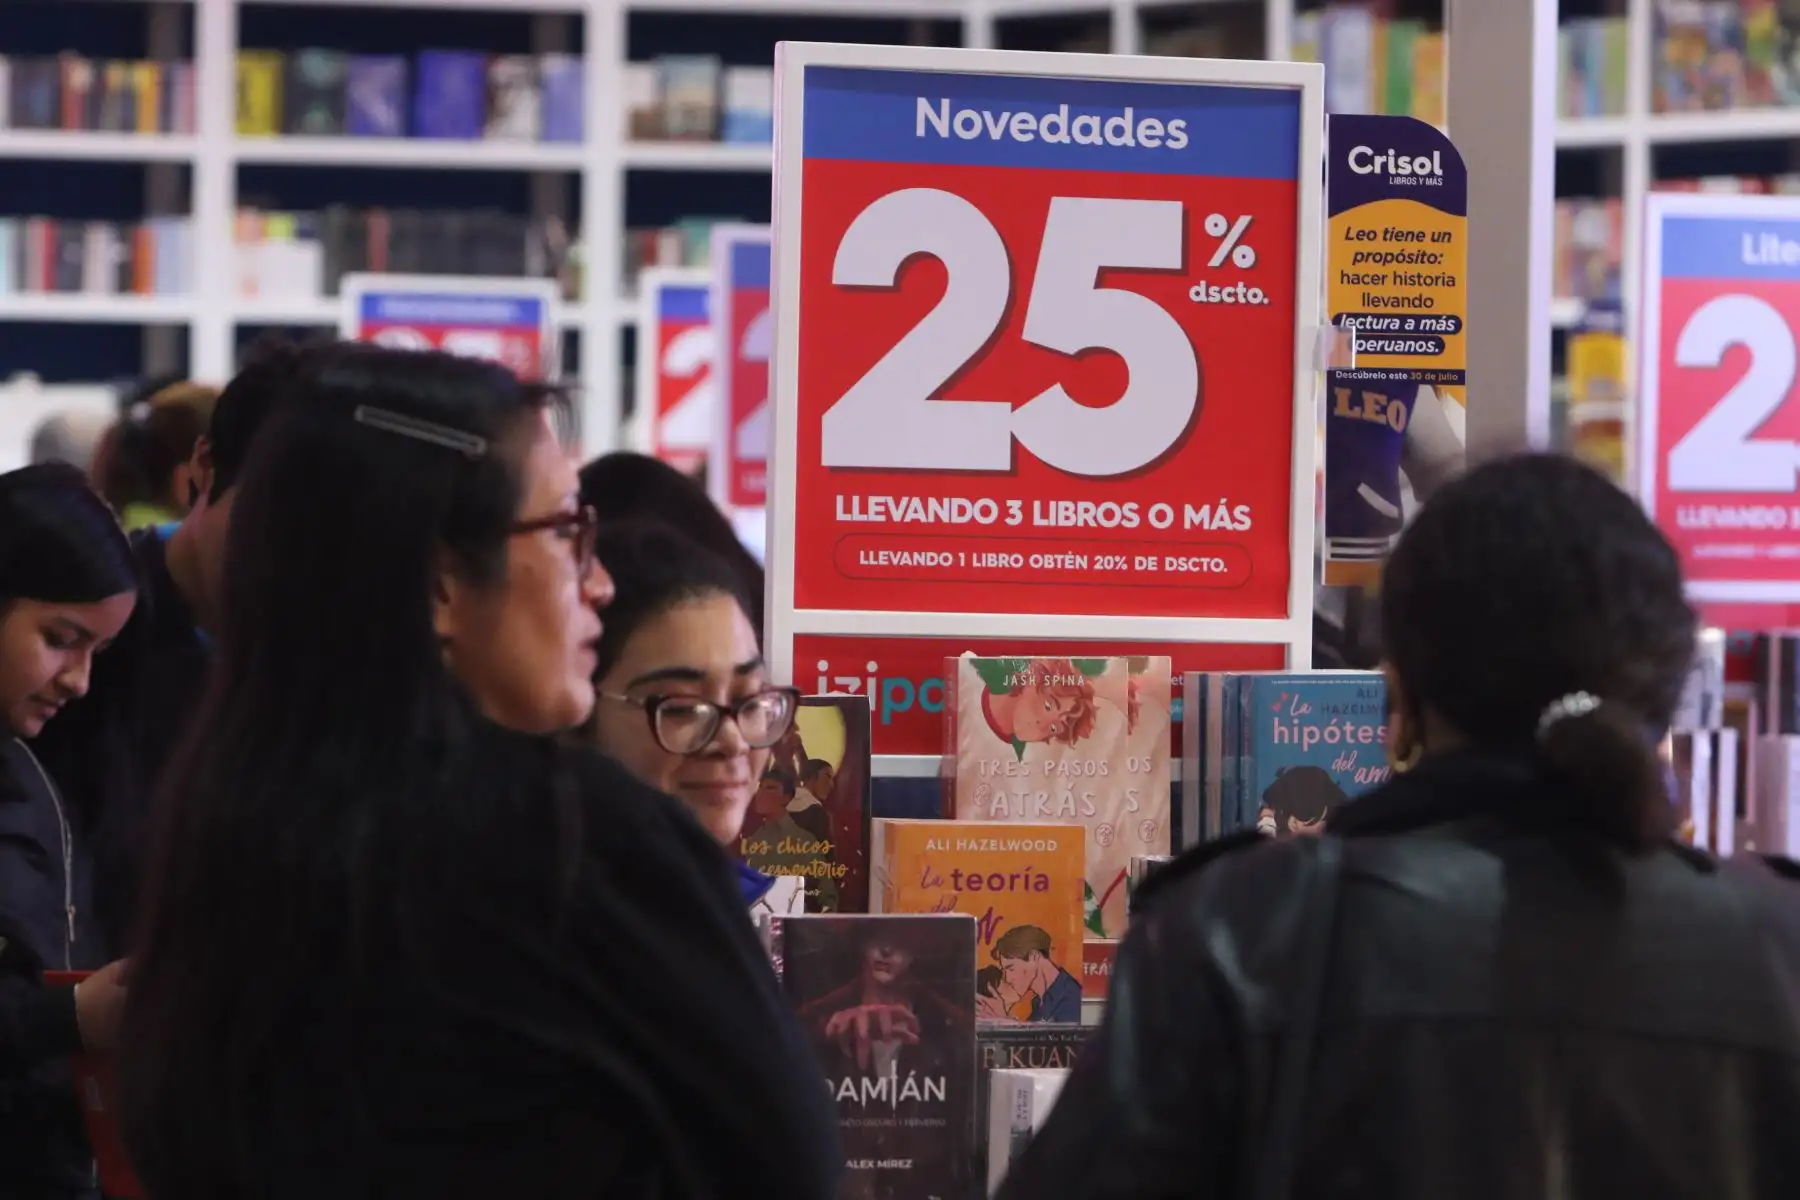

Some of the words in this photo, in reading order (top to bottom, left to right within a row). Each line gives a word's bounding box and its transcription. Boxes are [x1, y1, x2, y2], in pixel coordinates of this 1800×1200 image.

[915, 96, 1189, 150] Novedades
[1348, 145, 1443, 175] Crisol
[1389, 176, 1417, 186] LIBROS
[1419, 176, 1425, 185] Y
[1426, 175, 1443, 186] MÁS
[1204, 213, 1256, 269] %
[1345, 226, 1377, 242] Leo
[1382, 227, 1426, 243] tiene
[1430, 230, 1452, 244] un
[1352, 247, 1444, 267] propósito:
[1340, 269, 1388, 286] hacer
[1393, 270, 1456, 287] historia
[1189, 281, 1270, 304] dscto.
[1361, 292, 1434, 309] llevando
[821, 187, 1199, 476] 25
[1340, 314, 1400, 331] lectura
[1404, 318, 1414, 331] a
[1419, 314, 1456, 332] más
[1355, 336, 1440, 353] peruanos.
[1335, 370, 1387, 381] Descúbrelo
[1388, 371, 1408, 381] este
[1410, 371, 1422, 381] 30
[1424, 371, 1437, 381] de
[1667, 293, 1800, 491] 2
[1333, 386, 1408, 434] LEO
[836, 494, 998, 525] LLEVANDO
[1005, 500, 1024, 526] 3
[1033, 501, 1140, 530] LIBROS
[1148, 502, 1174, 530] O
[1184, 498, 1252, 532] MÁS
[859, 550, 953, 567] LLEVANDO
[959, 551, 965, 567] 1
[972, 552, 1024, 569] LIBRO
[1029, 548, 1089, 570] OBTÉN
[1093, 555, 1128, 572] 20%
[1135, 556, 1158, 572] DE
[1164, 556, 1229, 573] DSCTO.
[1003, 674, 1037, 687] JASH
[1044, 674, 1085, 687] SPINA
[1290, 693, 1312, 717] La
[977, 760, 1031, 777] TRES
[1044, 760, 1109, 778] PASOS
[1331, 750, 1358, 774] del
[990, 776, 1097, 818] ATRÁS
[741, 838, 773, 855] Los
[776, 836, 836, 854] chicos
[926, 837, 949, 852] ALI
[956, 838, 1058, 852] HAZELWOOD
[920, 865, 944, 889] La
[950, 865, 1050, 893] teoría
[845, 1159, 874, 1169] ALEX
[877, 1157, 913, 1169] MÍREZ
